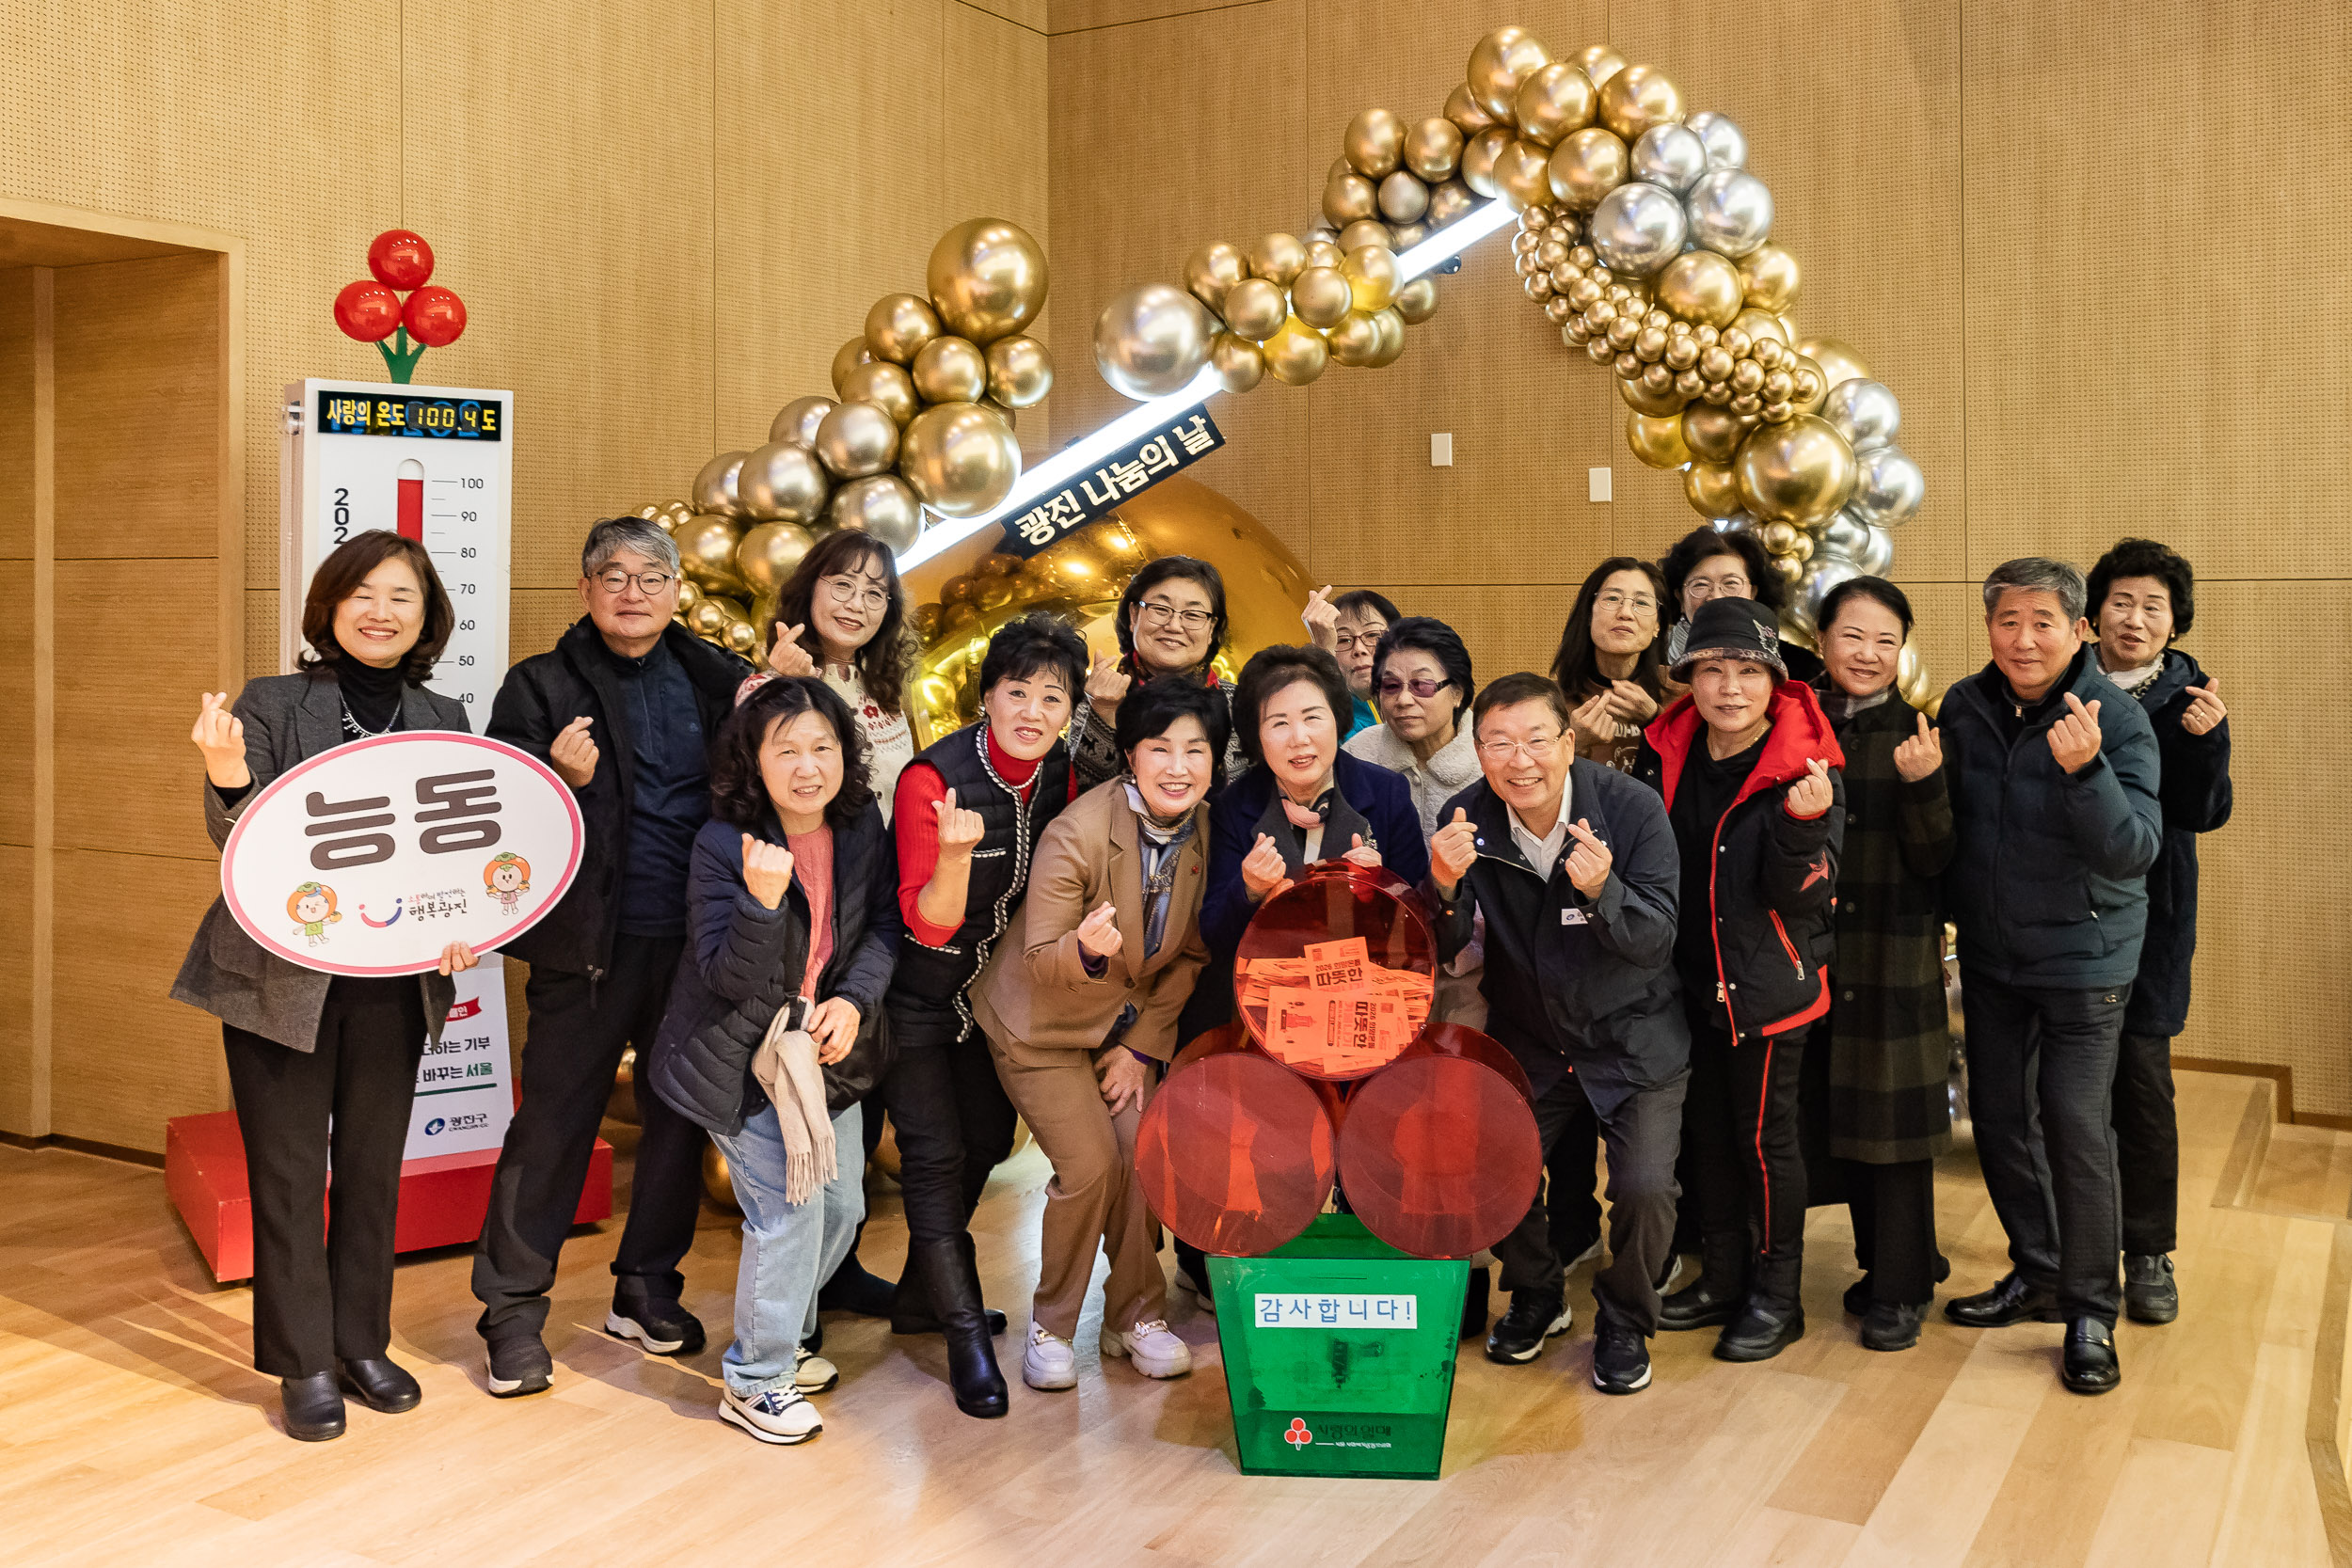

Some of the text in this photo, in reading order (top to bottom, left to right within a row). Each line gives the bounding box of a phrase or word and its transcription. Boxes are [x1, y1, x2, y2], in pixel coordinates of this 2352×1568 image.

[326, 399, 497, 431] 사랑의 온도 100.4 도
[460, 478, 484, 489] 100
[1014, 414, 1215, 546] 광진 나눔의 날
[461, 511, 477, 522] 90
[460, 547, 477, 558] 80
[460, 583, 476, 594] 70
[459, 620, 475, 631] 60
[458, 655, 475, 666] 50
[458, 692, 474, 704] 40
[304, 768, 502, 870] 능동
[409, 898, 468, 922] 행복광진
[1315, 967, 1363, 987] 따뜻한
[1353, 1001, 1369, 1049] 따뜻한
[464, 1036, 491, 1051] 기부
[422, 1066, 464, 1083] 바꾸는
[466, 1062, 493, 1078] 서울
[450, 1113, 488, 1127] 광진구
[1260, 1298, 1411, 1323] 감사합니다!
